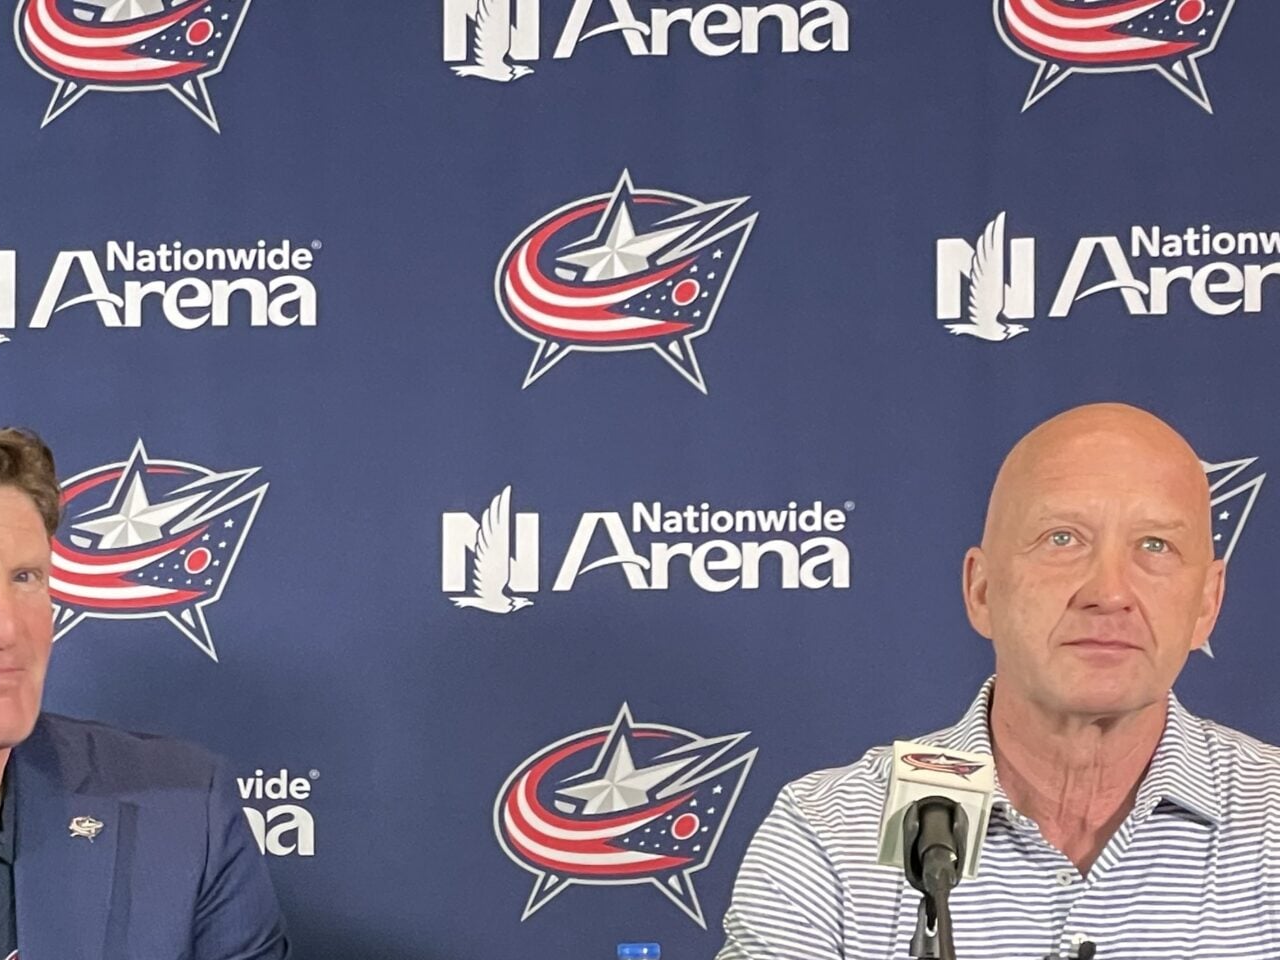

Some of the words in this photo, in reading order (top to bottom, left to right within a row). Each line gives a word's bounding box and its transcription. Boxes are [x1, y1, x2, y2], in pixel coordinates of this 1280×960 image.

[553, 0, 849, 58] Arena
[29, 251, 317, 329] Arena
[552, 512, 849, 592] Arena
